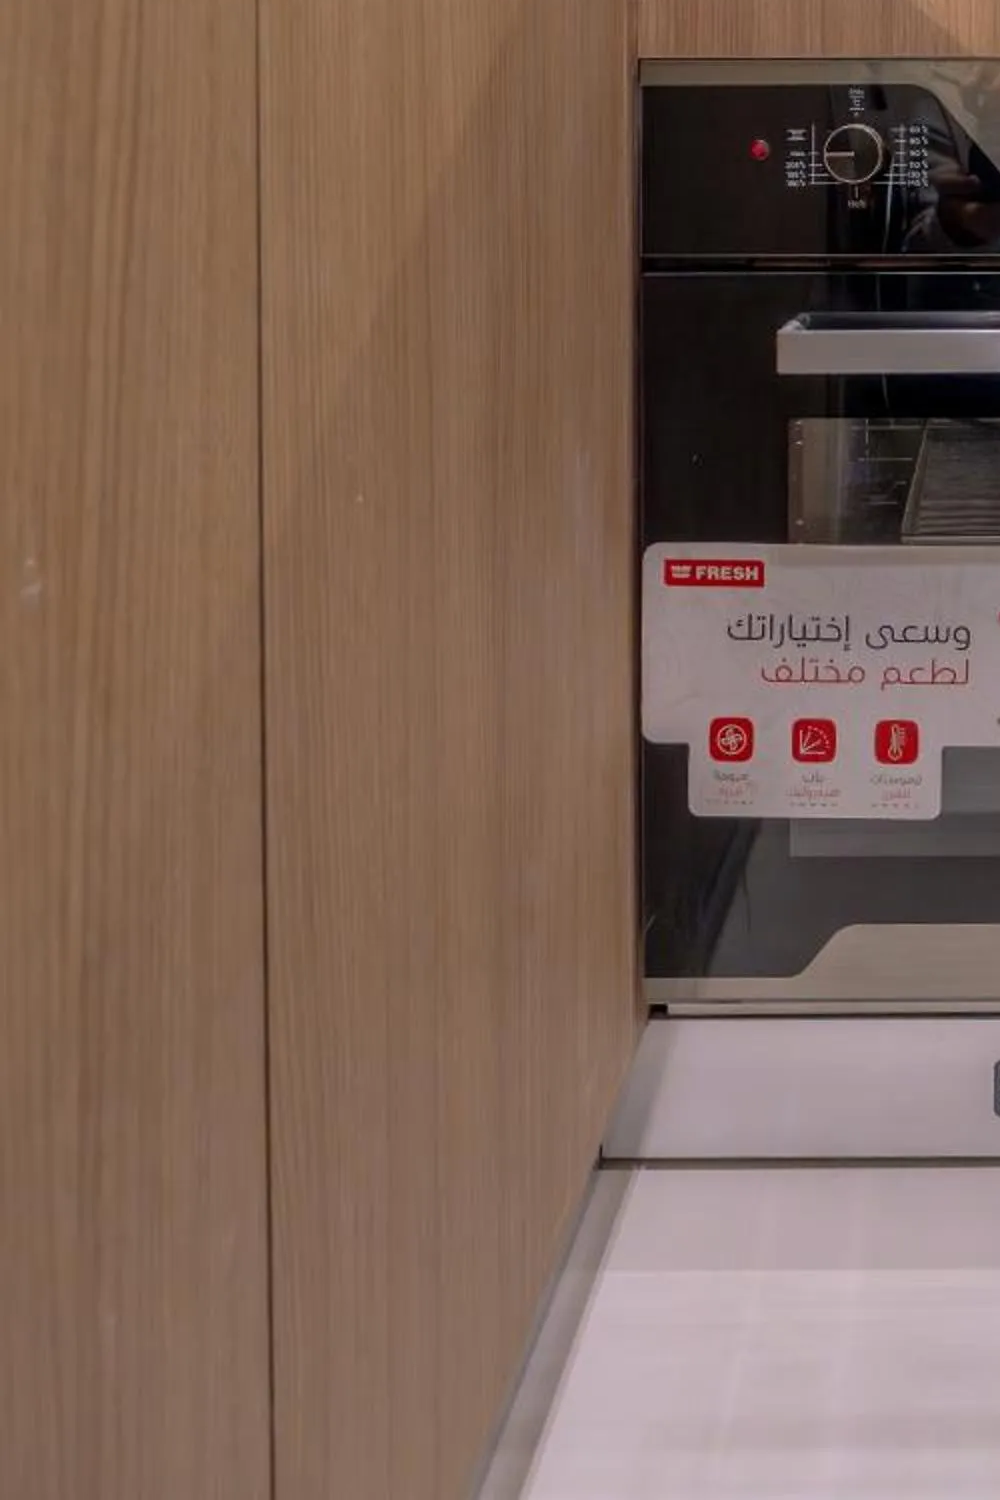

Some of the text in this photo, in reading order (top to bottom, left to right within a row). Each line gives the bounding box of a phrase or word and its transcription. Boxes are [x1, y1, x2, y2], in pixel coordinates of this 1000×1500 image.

[695, 564, 759, 581] FRESH
[726, 613, 971, 651] وسعى إختياراتك
[760, 656, 970, 691] لطعم مختلف
